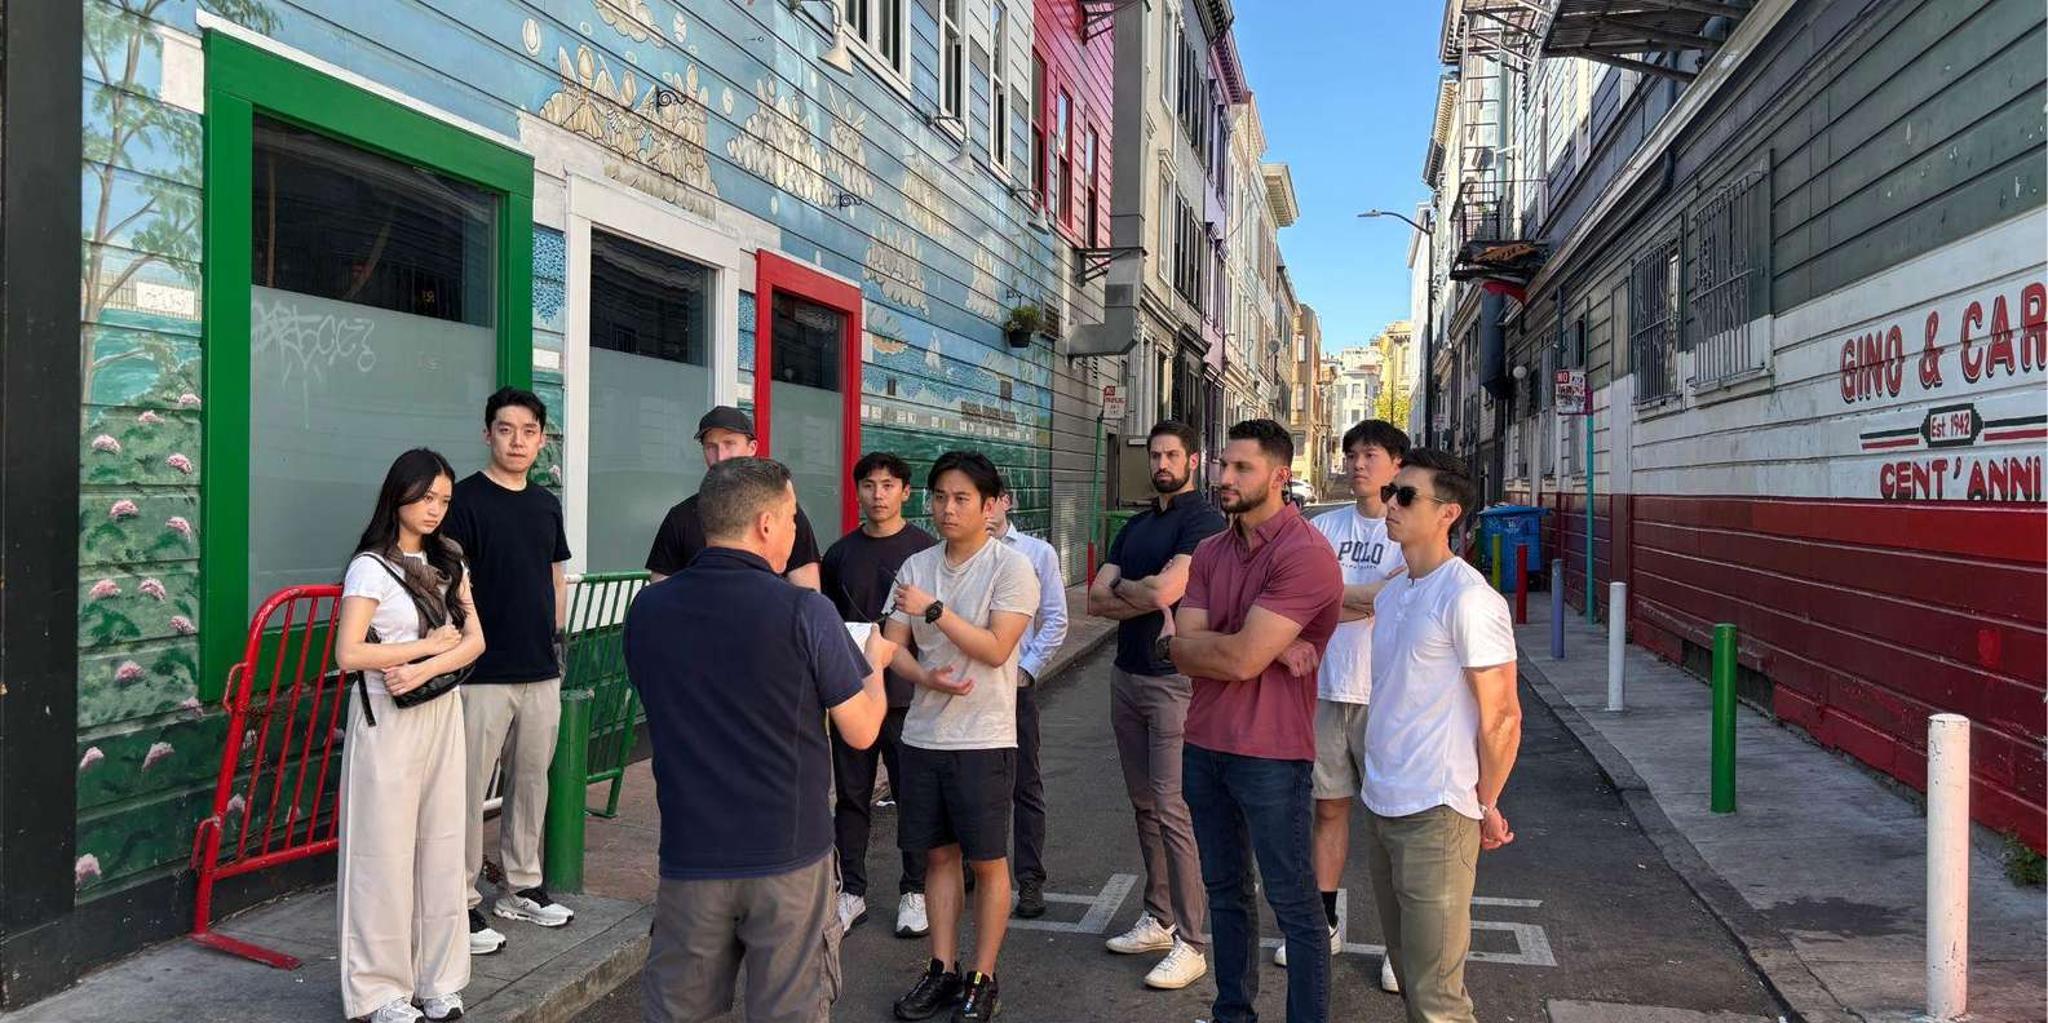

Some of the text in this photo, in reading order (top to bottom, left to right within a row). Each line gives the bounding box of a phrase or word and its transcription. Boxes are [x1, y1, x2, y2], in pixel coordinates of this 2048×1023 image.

[1841, 282, 2047, 404] GINO & CAR
[1557, 372, 1568, 382] NO
[1931, 412, 1970, 438] Est 1942
[1338, 540, 1384, 565] POLO
